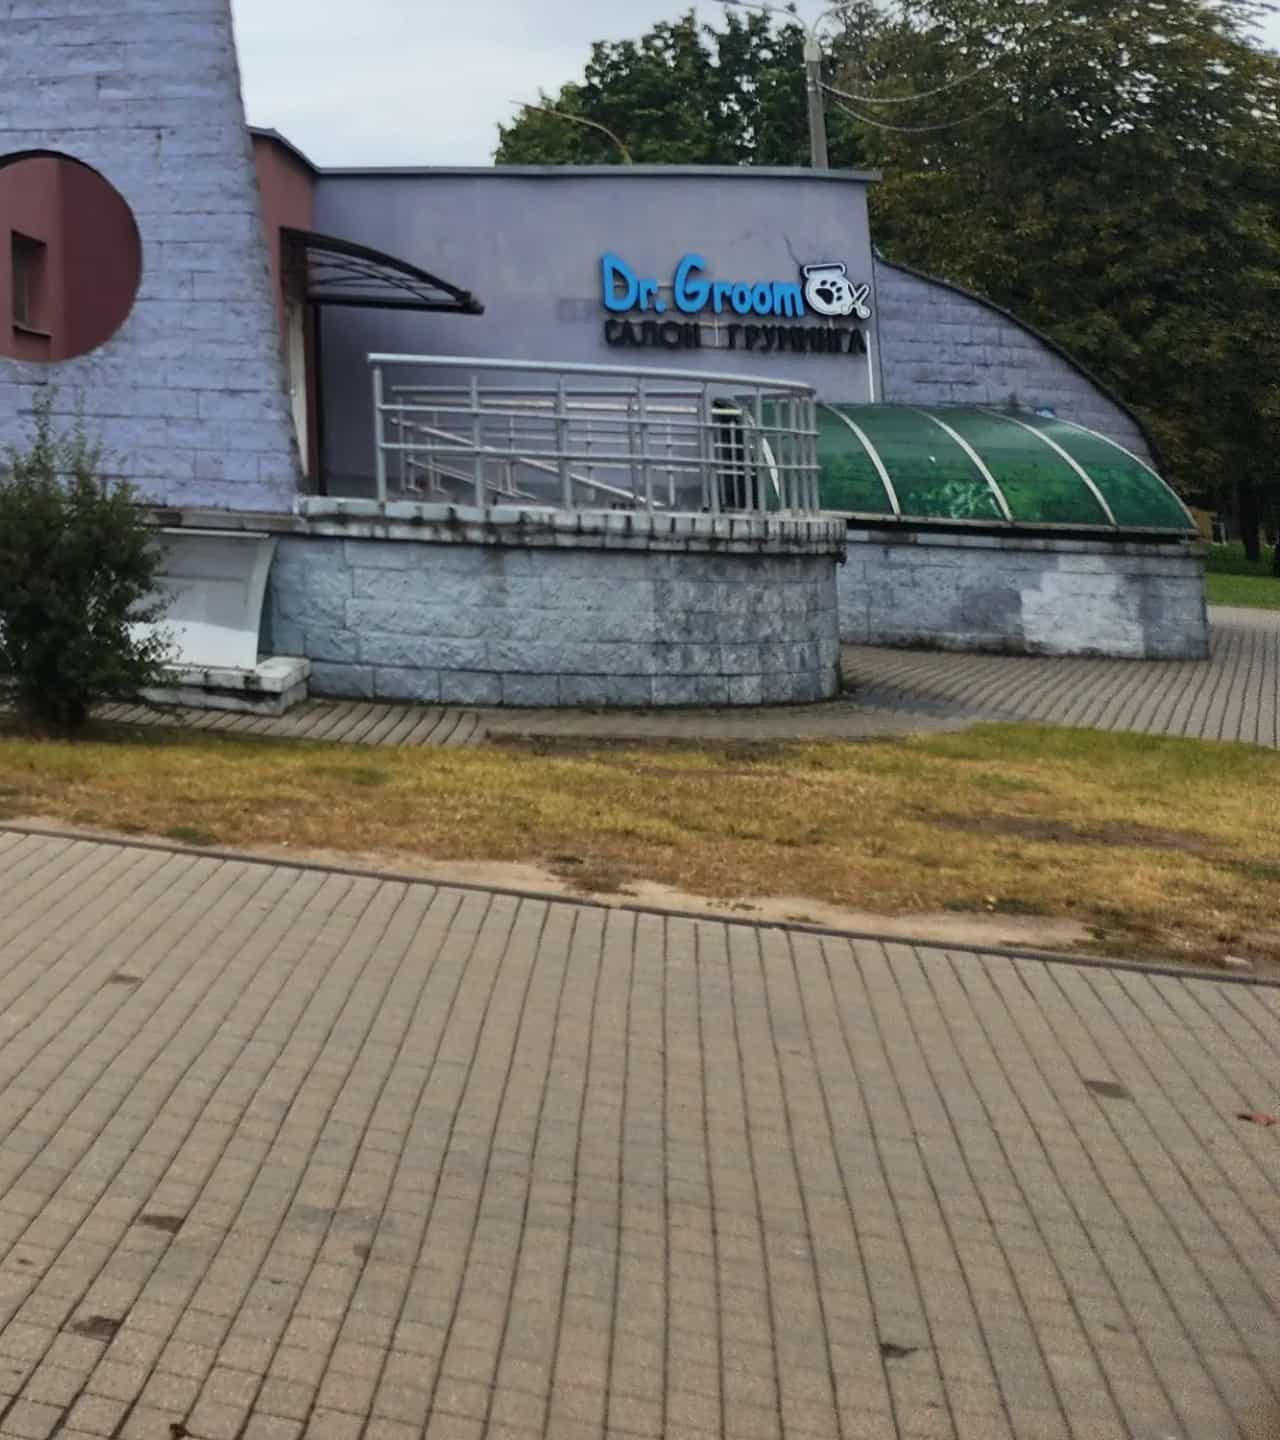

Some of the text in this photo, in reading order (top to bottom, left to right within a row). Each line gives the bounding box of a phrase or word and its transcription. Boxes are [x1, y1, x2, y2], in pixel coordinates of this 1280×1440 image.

[602, 253, 805, 318] Dr. Groom
[603, 318, 702, 349] САЛОН
